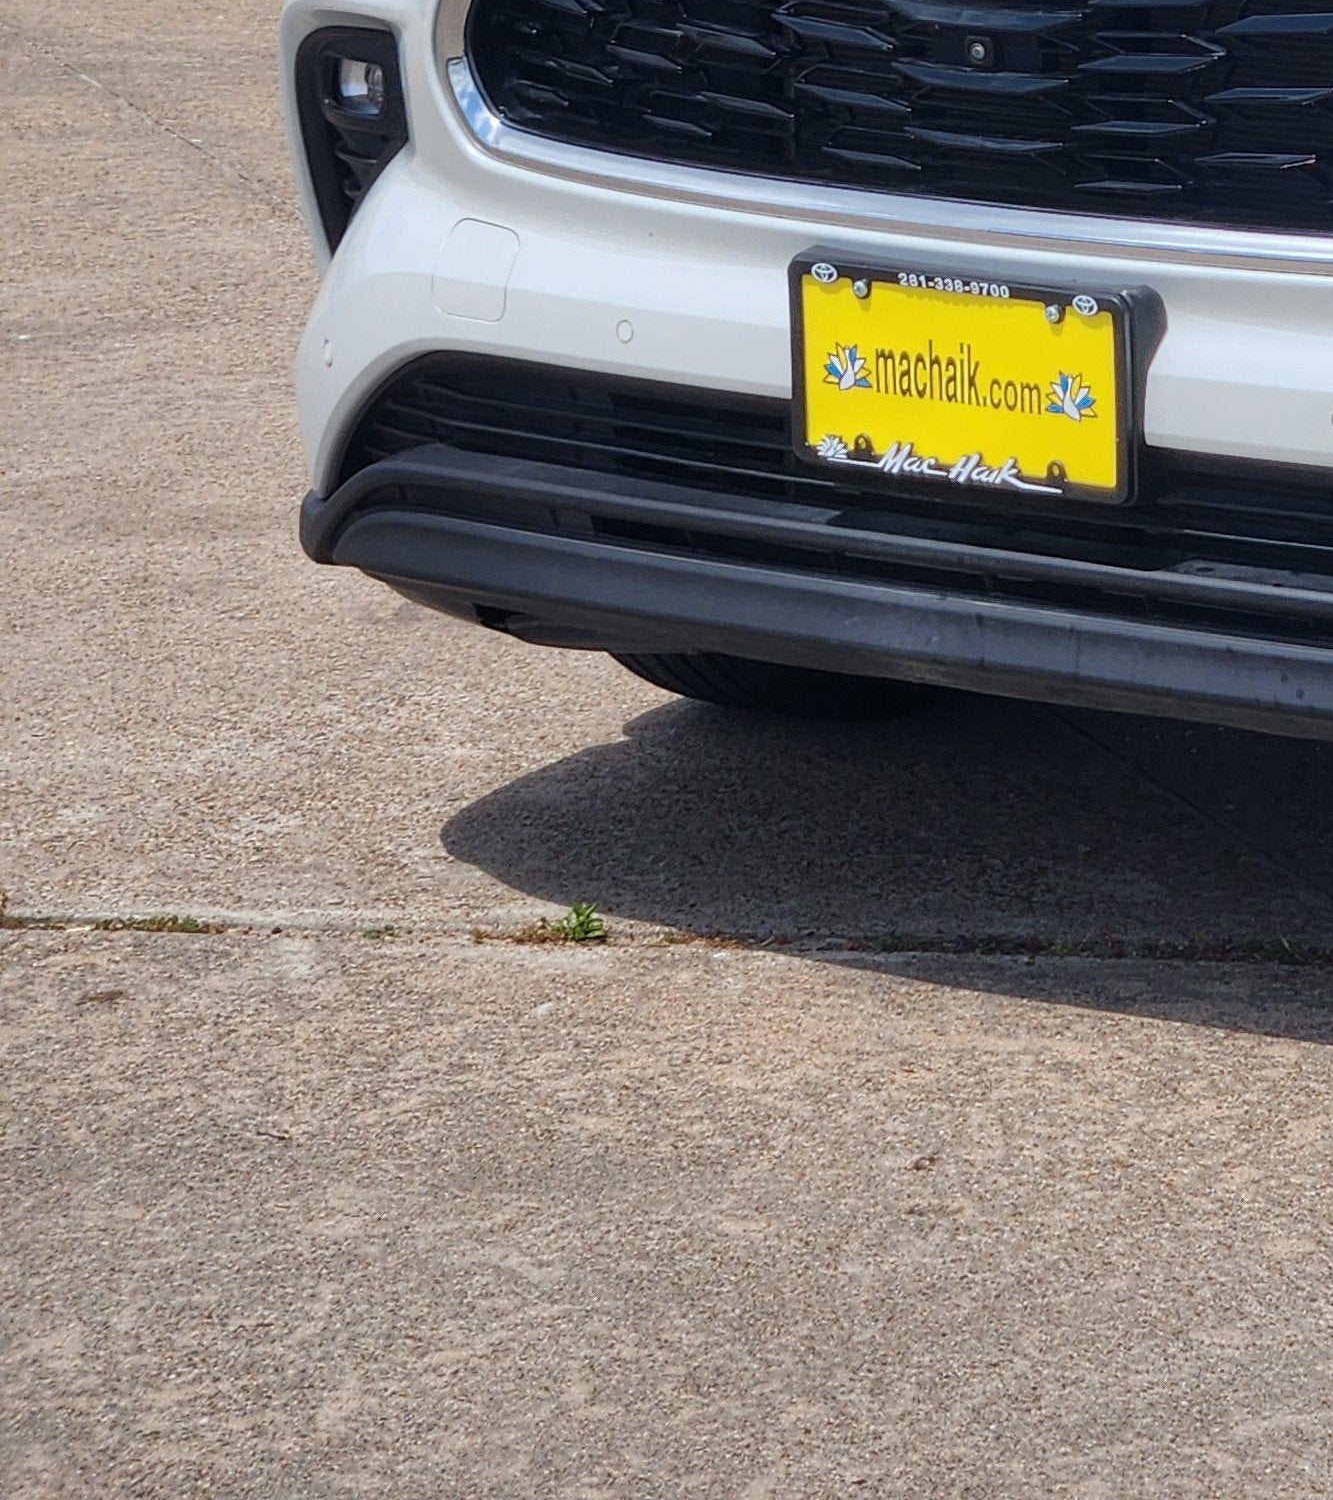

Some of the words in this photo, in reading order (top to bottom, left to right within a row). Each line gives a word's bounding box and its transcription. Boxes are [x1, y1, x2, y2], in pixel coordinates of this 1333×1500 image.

[897, 272, 1010, 299] 281-338-9700
[874, 339, 1043, 416] machaik.com
[877, 440, 948, 476] Mac
